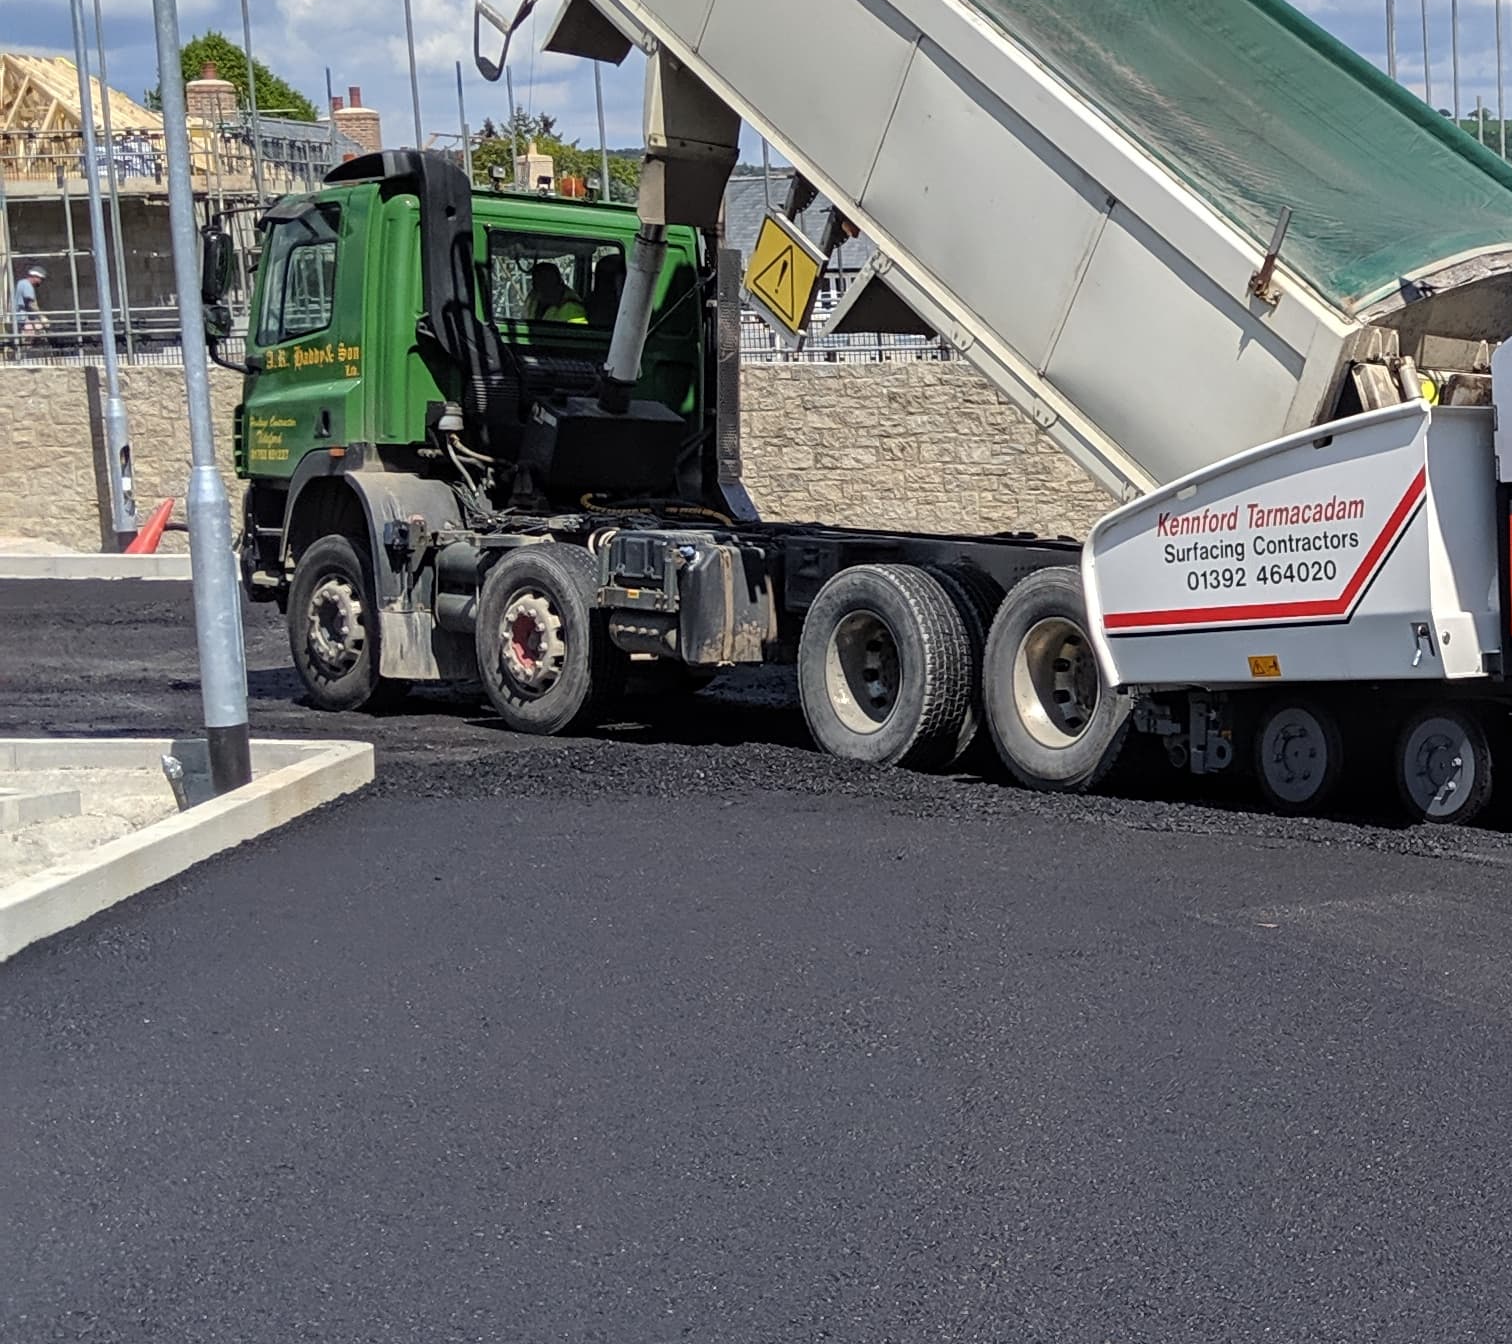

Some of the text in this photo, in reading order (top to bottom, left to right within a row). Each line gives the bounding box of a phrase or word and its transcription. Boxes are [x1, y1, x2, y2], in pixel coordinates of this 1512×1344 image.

[337, 342, 360, 362] Son
[1156, 495, 1365, 538] Kennford Tarmacadam
[1164, 531, 1360, 564] Surfacing Contractors
[1187, 560, 1337, 591] 01392 464020
